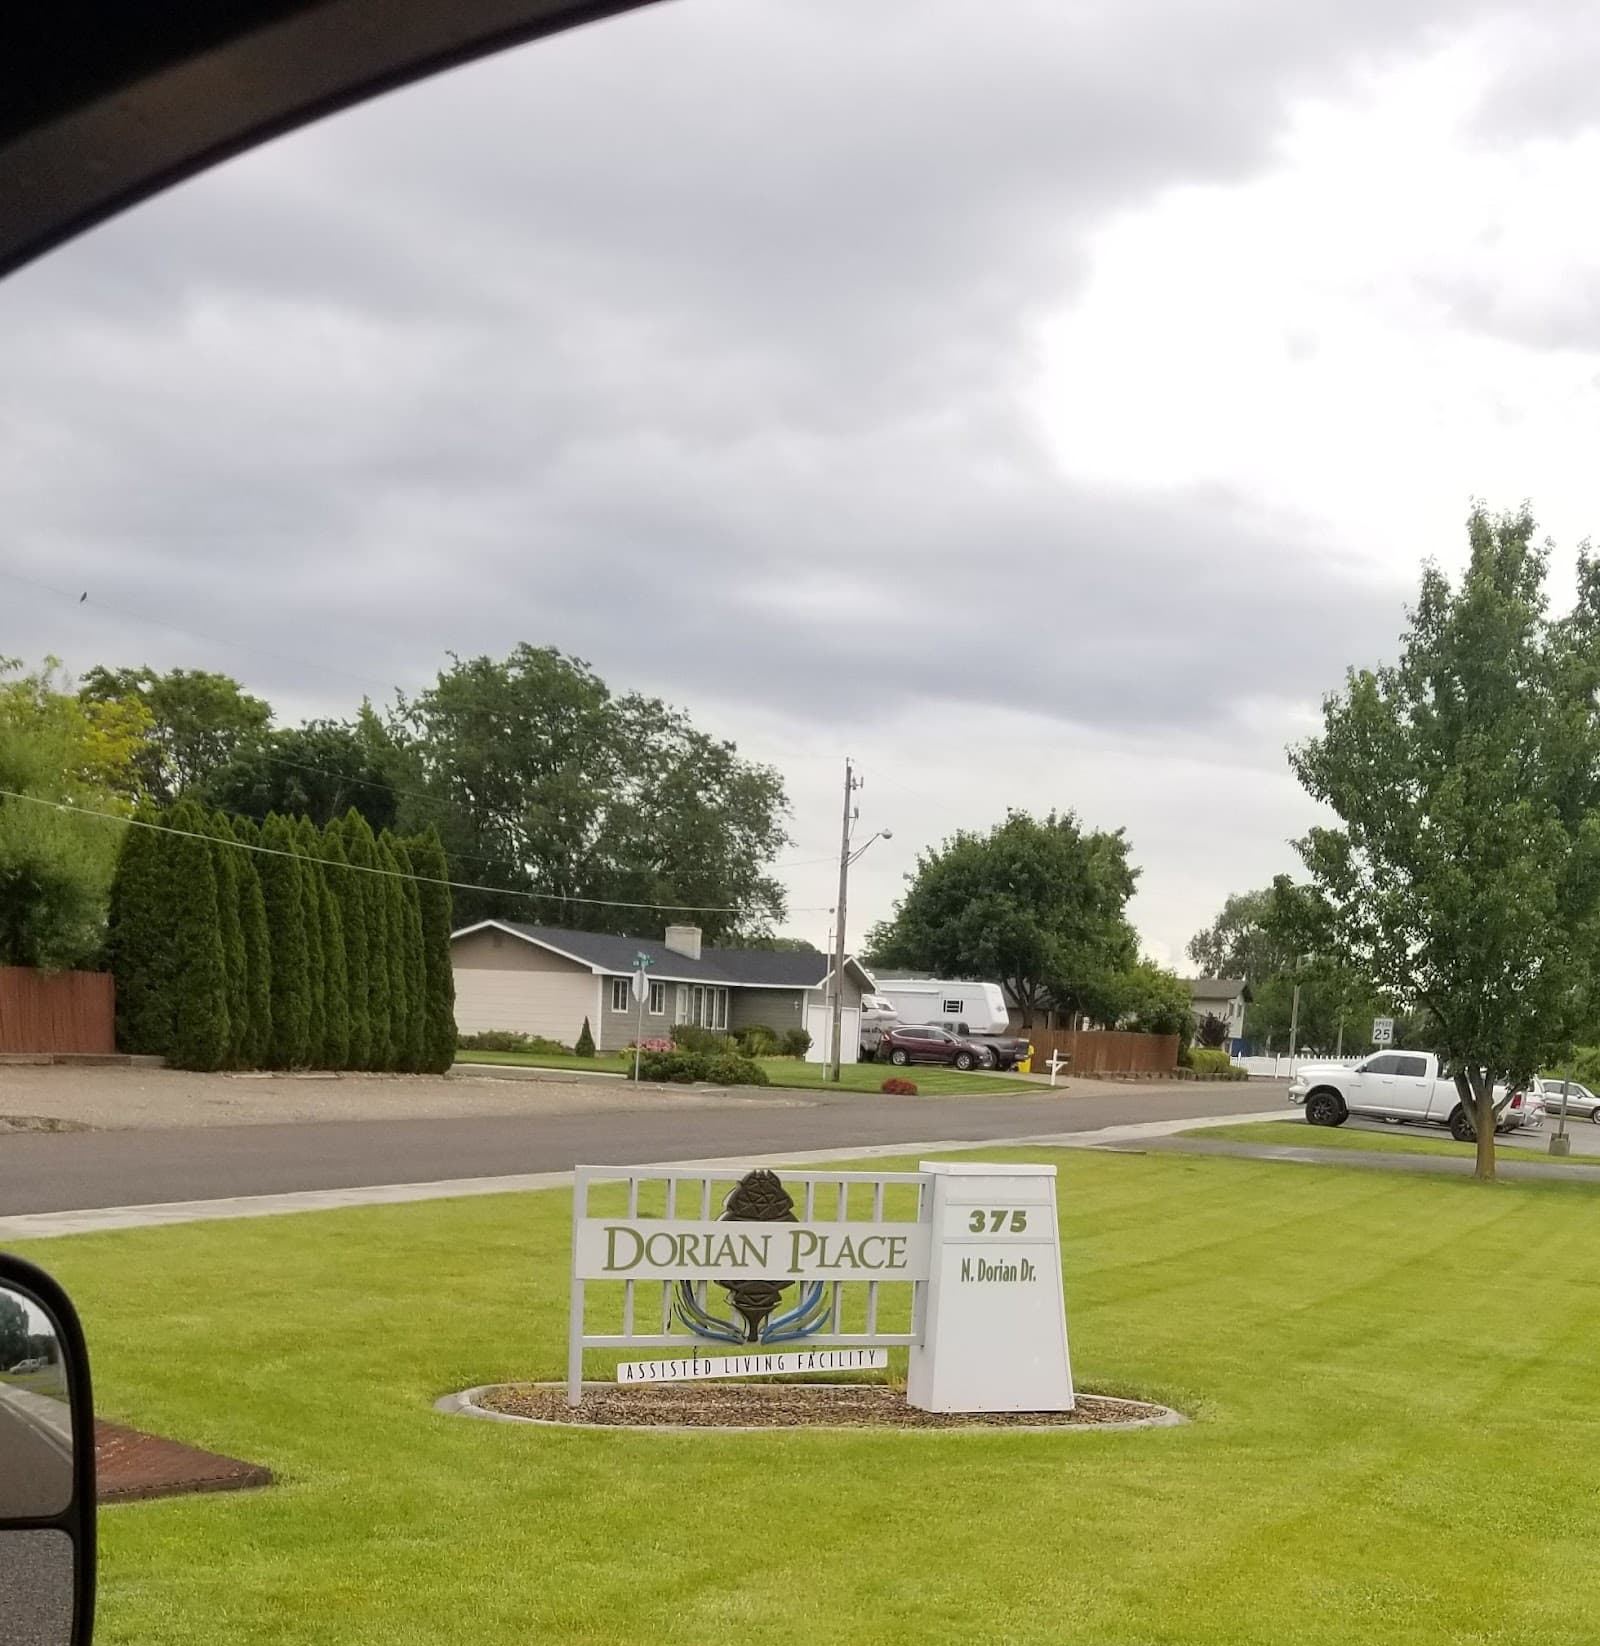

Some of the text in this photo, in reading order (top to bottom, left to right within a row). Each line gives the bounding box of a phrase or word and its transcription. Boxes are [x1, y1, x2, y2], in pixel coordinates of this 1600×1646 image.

[1374, 1028, 1390, 1040] 25
[968, 1209, 1027, 1233] 375
[602, 1226, 908, 1273] DORIAN PLACE
[961, 1257, 1036, 1282] N. Dorian Dr.
[627, 1349, 876, 1380] ASSISTED LIVING FACILITY
